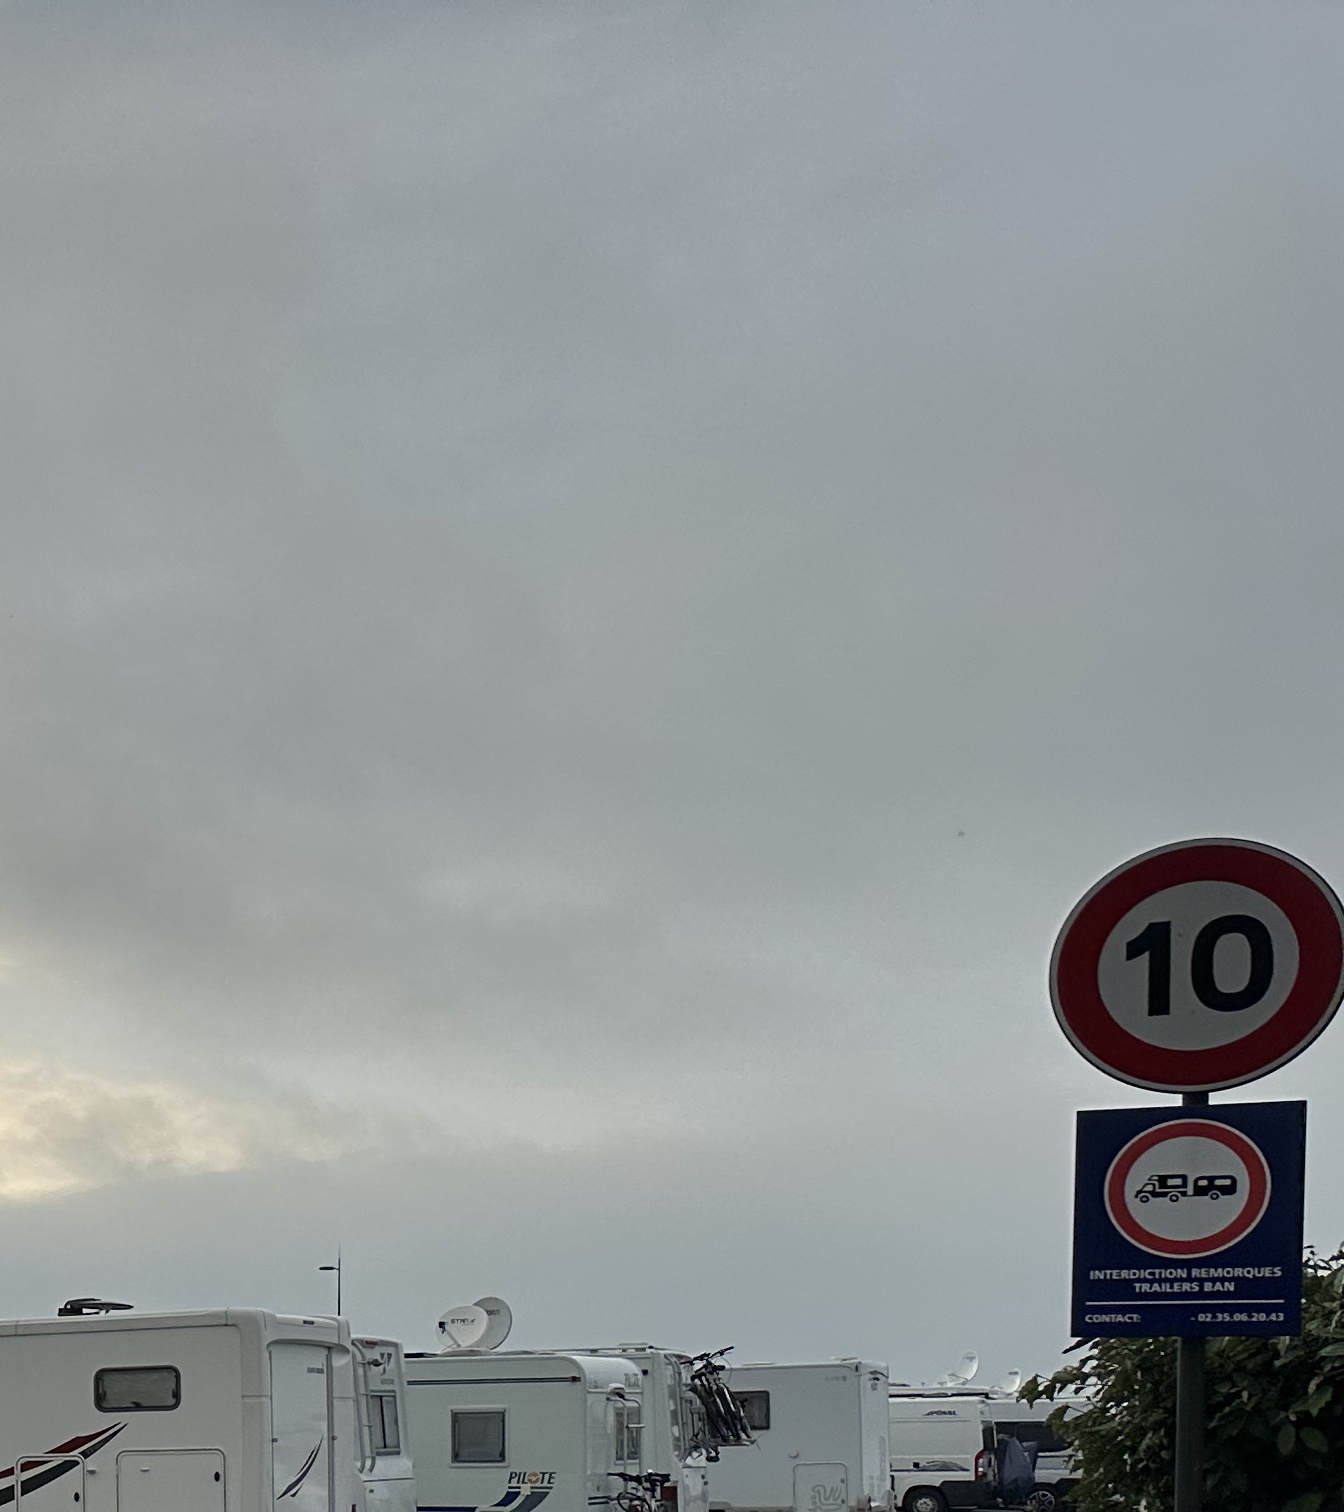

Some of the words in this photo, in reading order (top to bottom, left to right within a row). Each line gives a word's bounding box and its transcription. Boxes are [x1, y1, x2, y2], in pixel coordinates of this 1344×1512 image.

[1125, 914, 1274, 1017] 10
[1089, 1268, 1188, 1280] INTERDICTION
[1191, 1266, 1283, 1279] REMORQUES
[1133, 1282, 1200, 1293] TRAILERS
[1203, 1281, 1236, 1292] BAN
[508, 1471, 557, 1485] PILOTE
